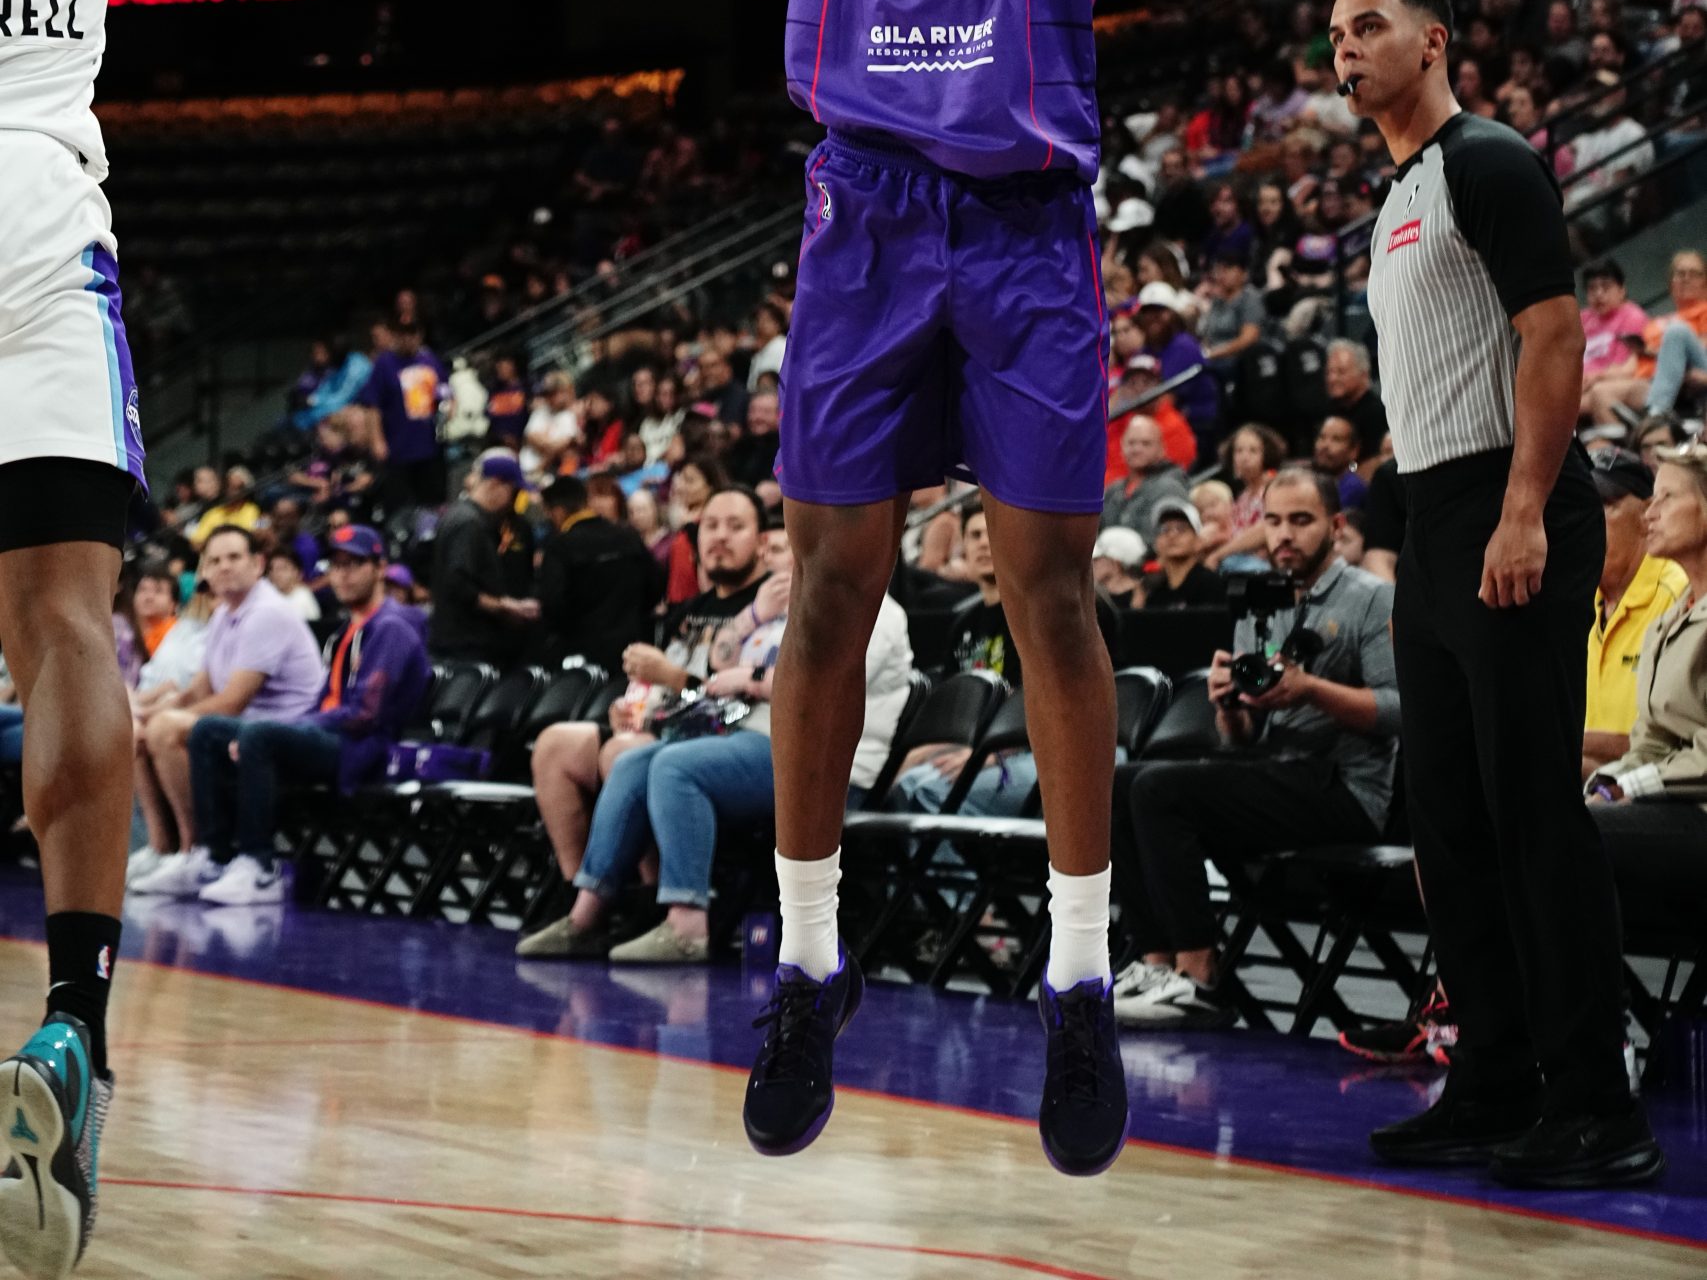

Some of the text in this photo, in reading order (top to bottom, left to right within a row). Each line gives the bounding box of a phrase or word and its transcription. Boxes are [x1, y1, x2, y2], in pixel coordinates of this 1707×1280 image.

[870, 18, 993, 44] GILA RIVER
[867, 39, 993, 57] RESORTS & CASINOS
